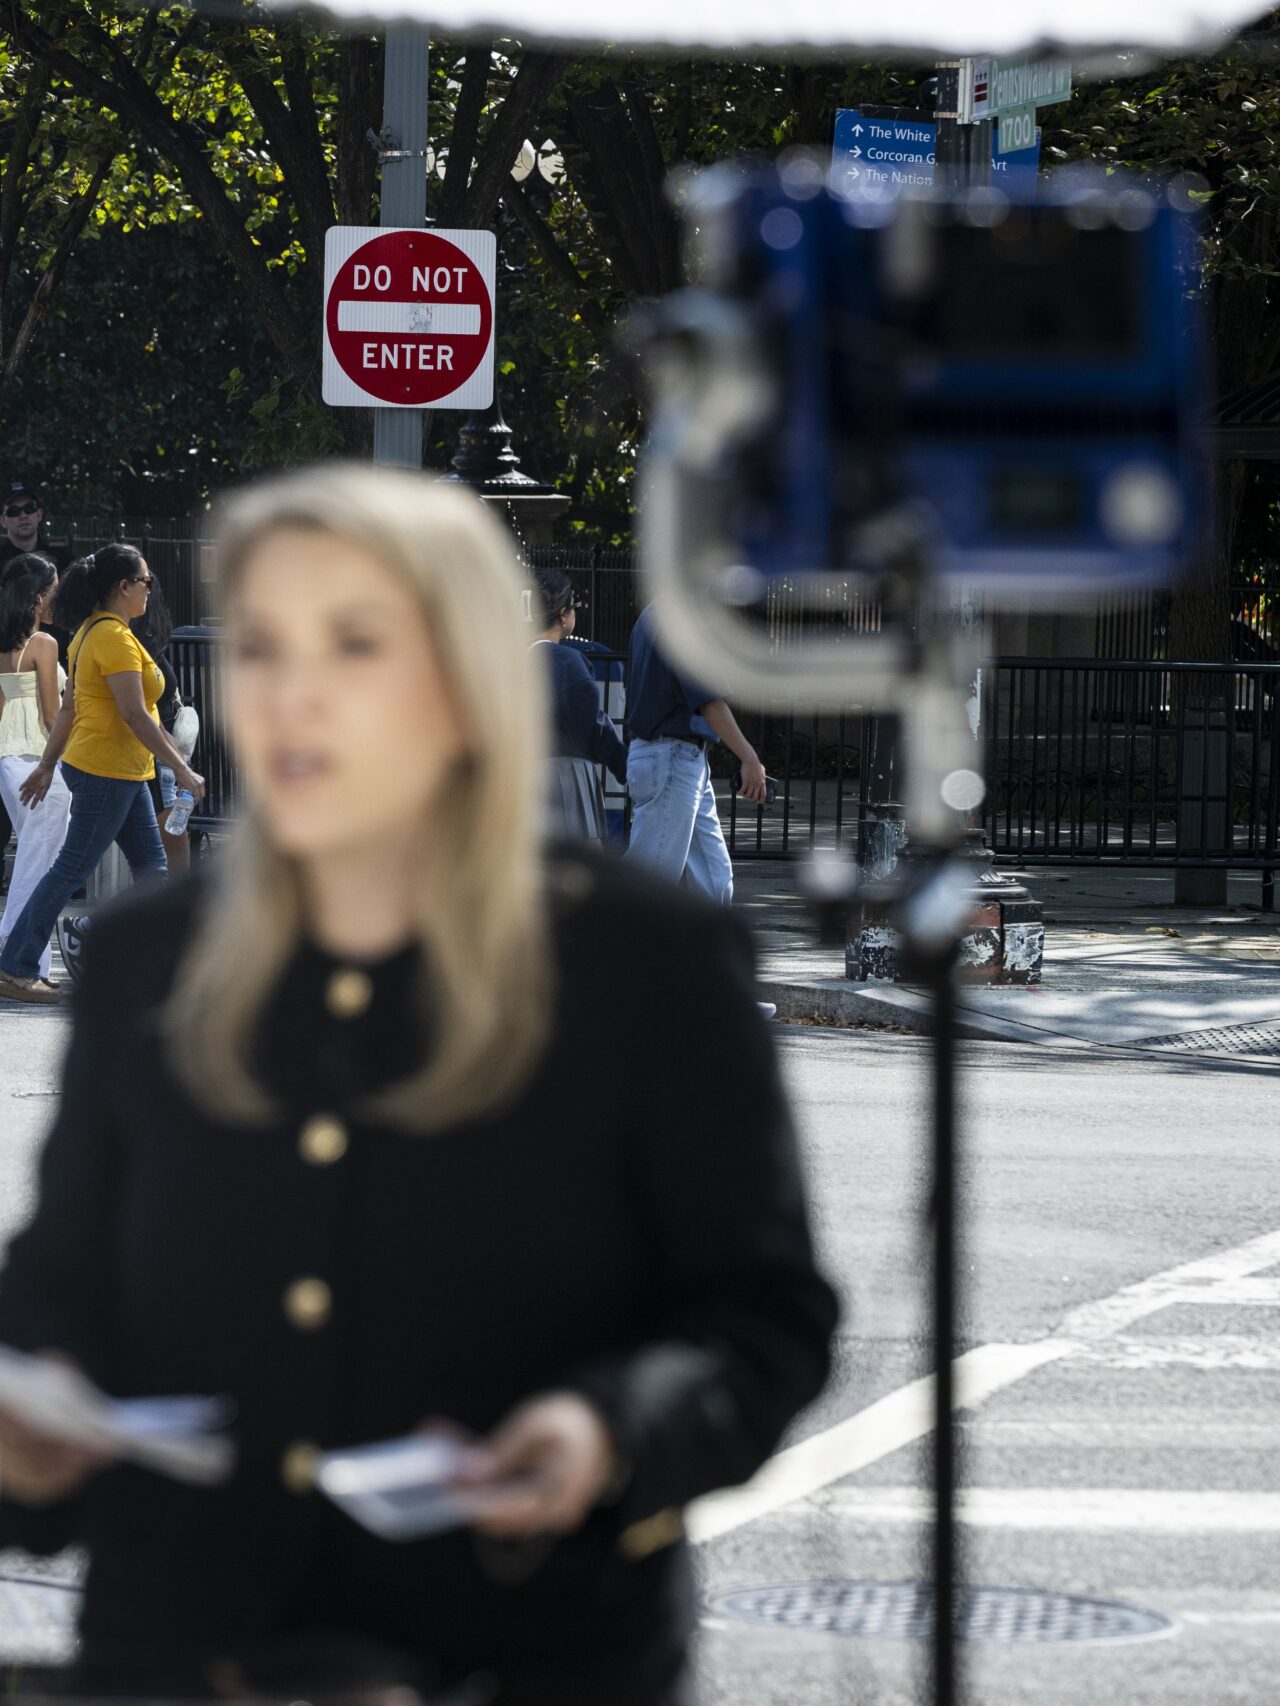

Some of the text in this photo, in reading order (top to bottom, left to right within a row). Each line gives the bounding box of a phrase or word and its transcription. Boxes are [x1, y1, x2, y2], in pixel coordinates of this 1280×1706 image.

[869, 125, 892, 139] The
[894, 128, 931, 142] White
[1002, 113, 1031, 148] 1700
[867, 147, 923, 163] Corcoran
[865, 168, 888, 182] The
[353, 264, 468, 293] DO NOT
[362, 342, 454, 371] ENTER
